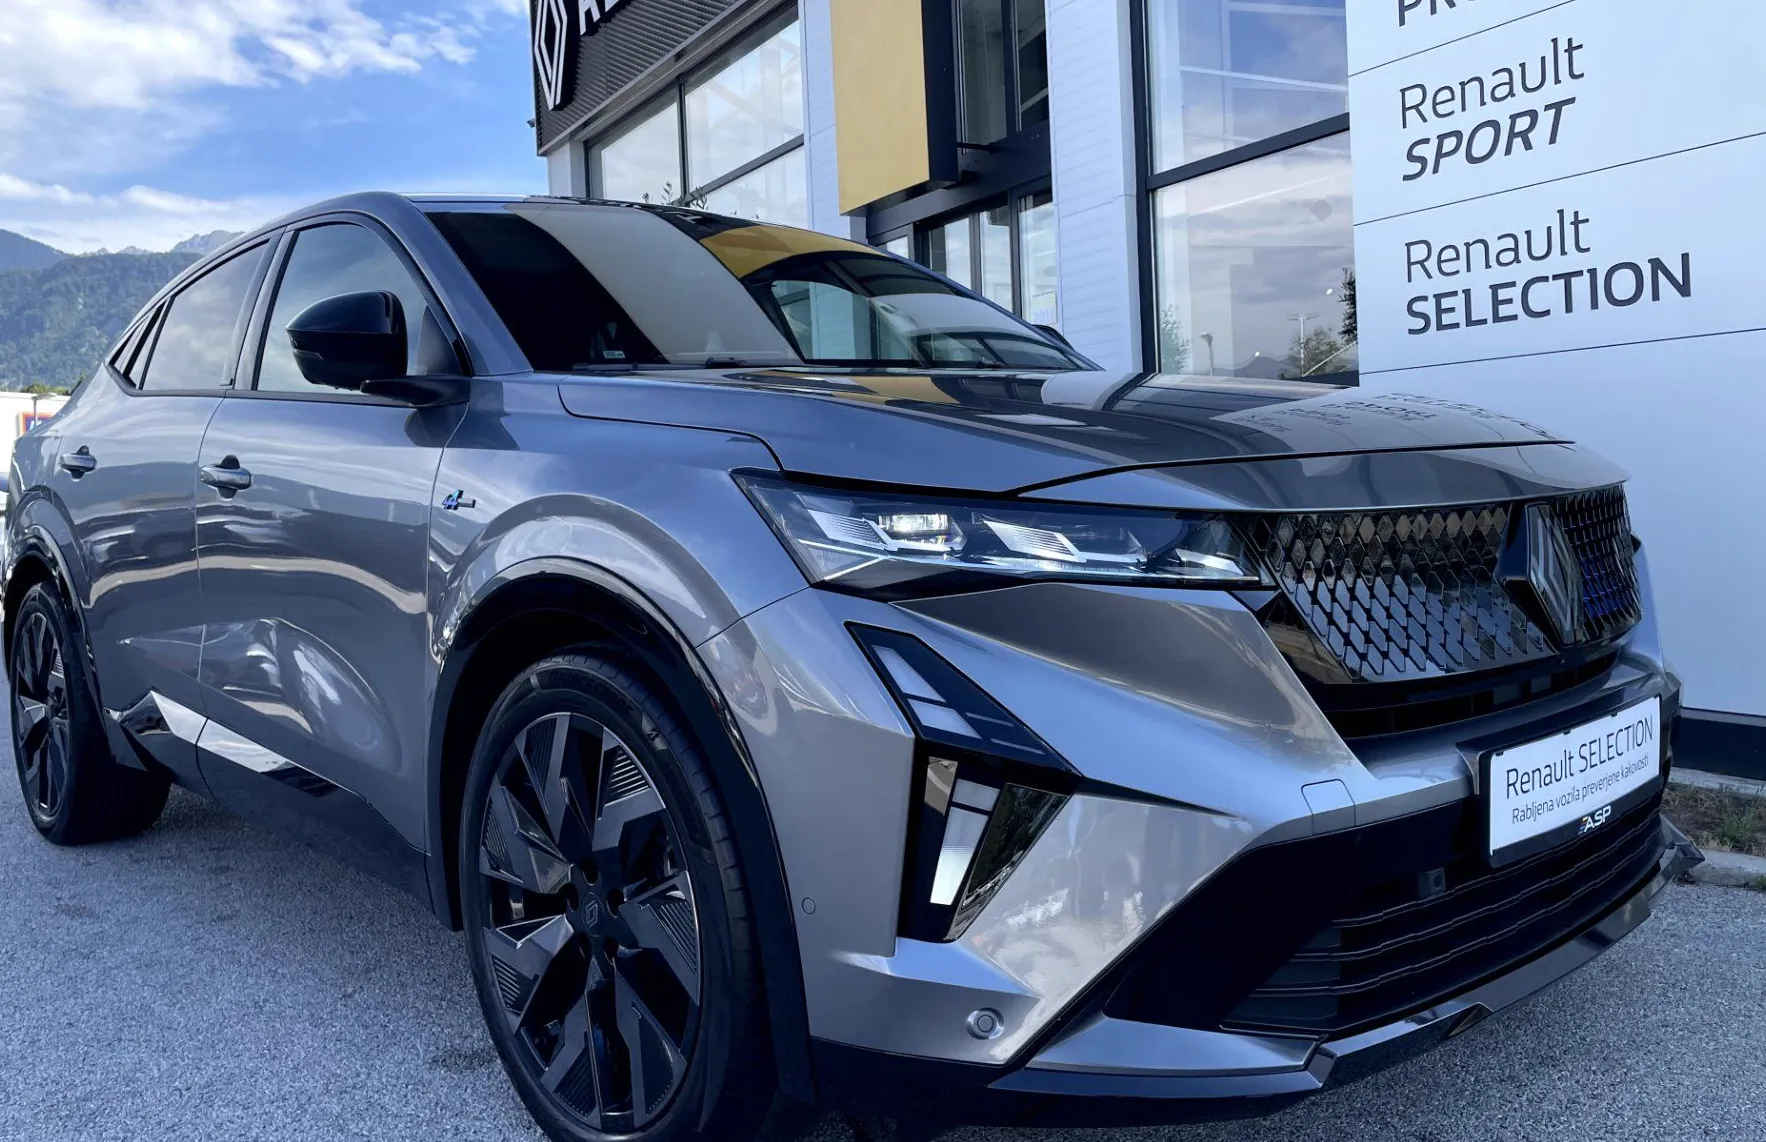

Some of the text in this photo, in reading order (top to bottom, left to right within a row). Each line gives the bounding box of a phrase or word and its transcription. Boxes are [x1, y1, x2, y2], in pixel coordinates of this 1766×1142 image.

[1400, 37, 1585, 129] Renault
[1402, 97, 1577, 182] SPORT
[1405, 209, 1591, 283] Renault
[1407, 252, 1692, 336] SELECTION
[1506, 714, 1653, 799] Renault SELECTION
[1512, 754, 1649, 824] Rabljena vozila preverjene kakovosti
[1583, 805, 1612, 833] ASP
